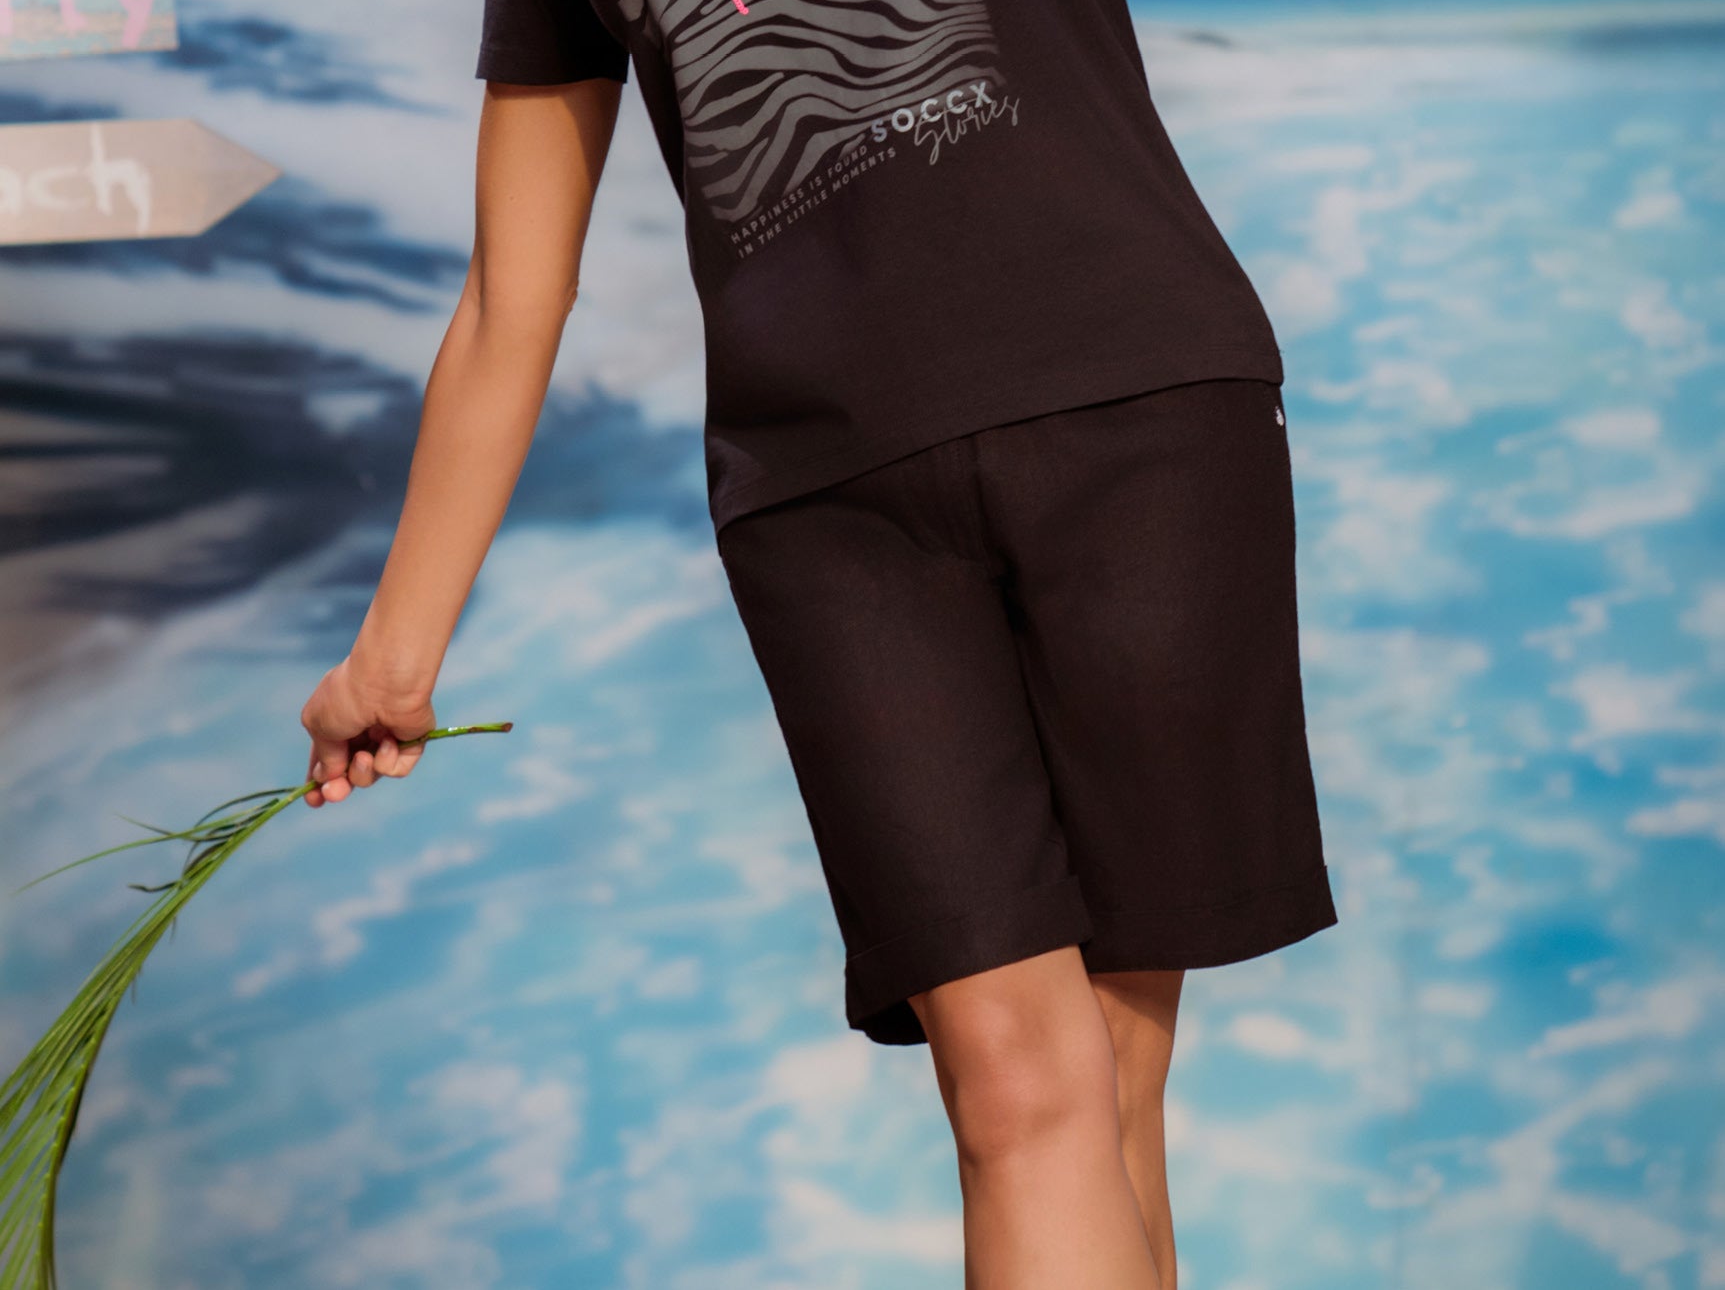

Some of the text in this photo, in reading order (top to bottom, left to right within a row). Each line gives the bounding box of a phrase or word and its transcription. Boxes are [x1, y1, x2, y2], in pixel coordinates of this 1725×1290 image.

[871, 81, 992, 142] SOCCX
[730, 145, 868, 244] HAPPINESS IS FOUND
[738, 147, 897, 259] IN THE LITTLE MOMENTS
